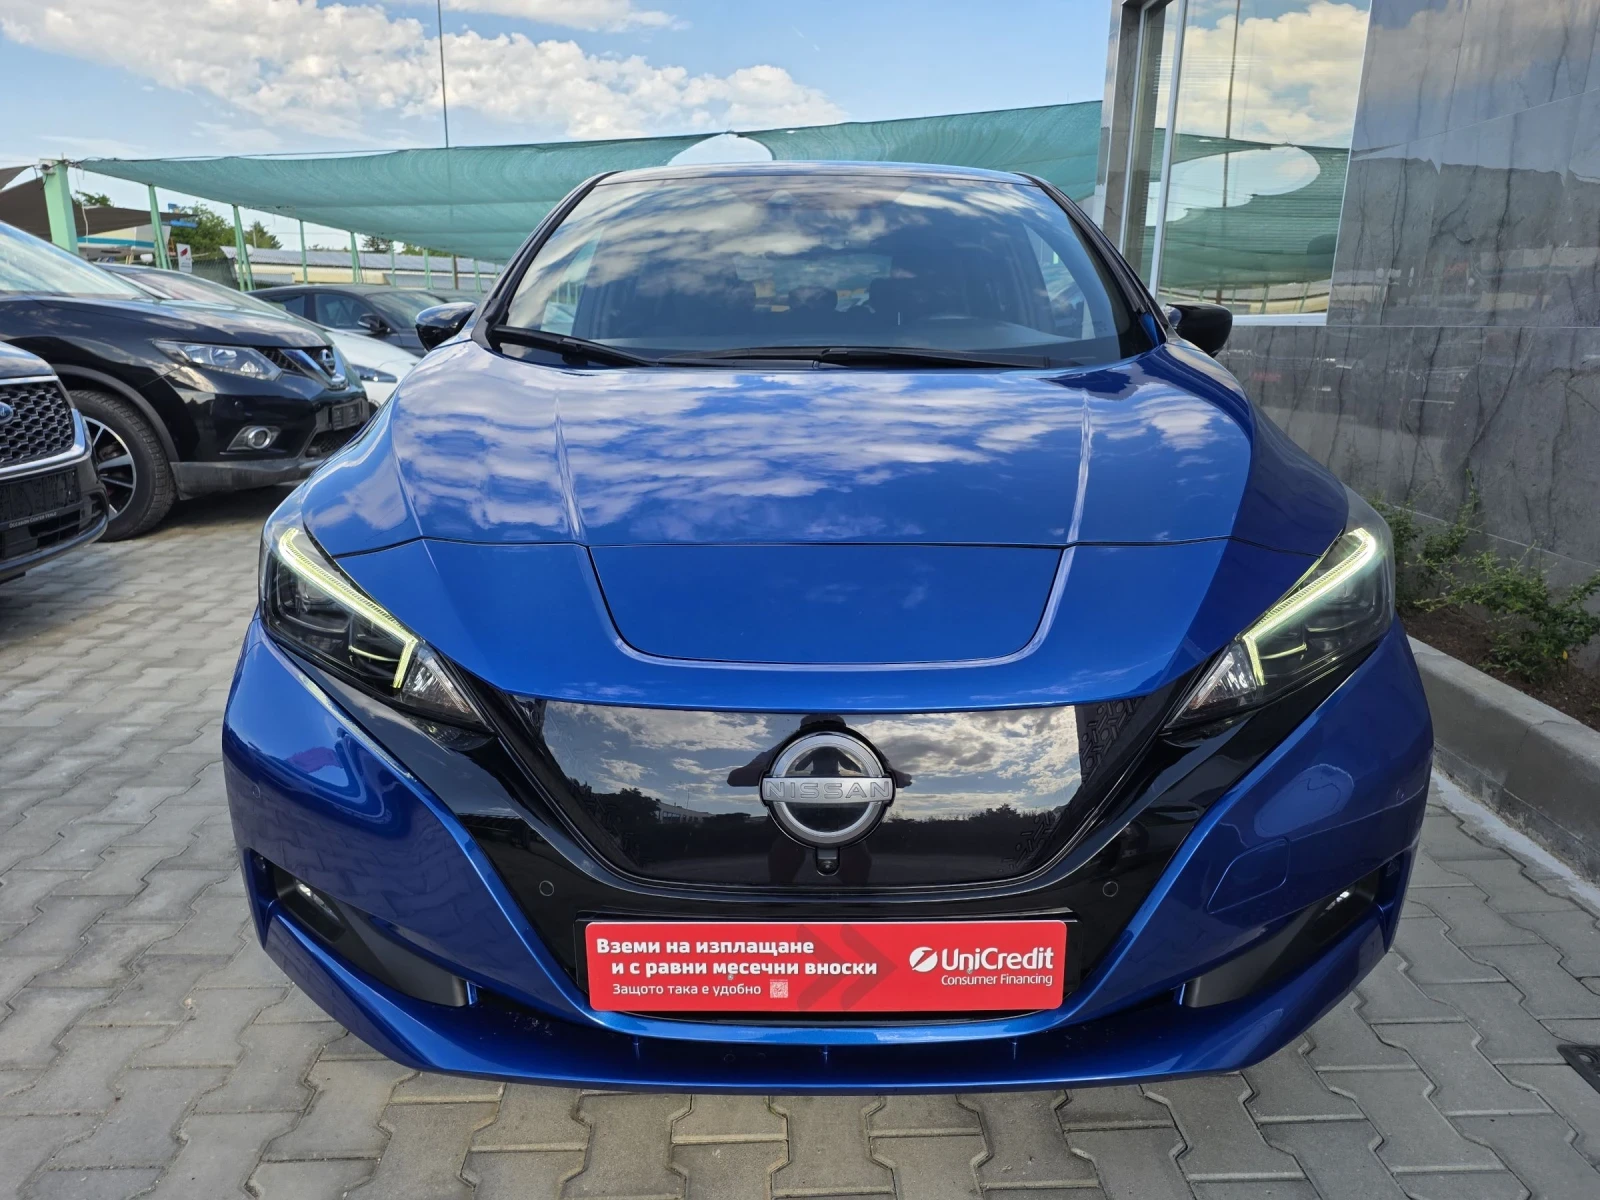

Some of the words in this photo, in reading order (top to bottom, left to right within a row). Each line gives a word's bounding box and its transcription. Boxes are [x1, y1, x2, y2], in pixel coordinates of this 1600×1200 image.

[765, 781, 890, 799] NISSAN
[596, 938, 661, 954] Вземи
[666, 941, 690, 954] на
[696, 941, 815, 956] изплащане
[941, 947, 1054, 971] UniCredit
[611, 962, 625, 975] и
[629, 962, 641, 975] с
[645, 962, 708, 978] равни
[713, 962, 799, 975] месечни
[805, 962, 878, 975] вноски
[941, 974, 997, 986] Consumer
[1000, 973, 1053, 987] Financing
[612, 983, 664, 996] Защото
[667, 985, 699, 995] така
[702, 985, 710, 995] е
[713, 983, 762, 997] удобно
